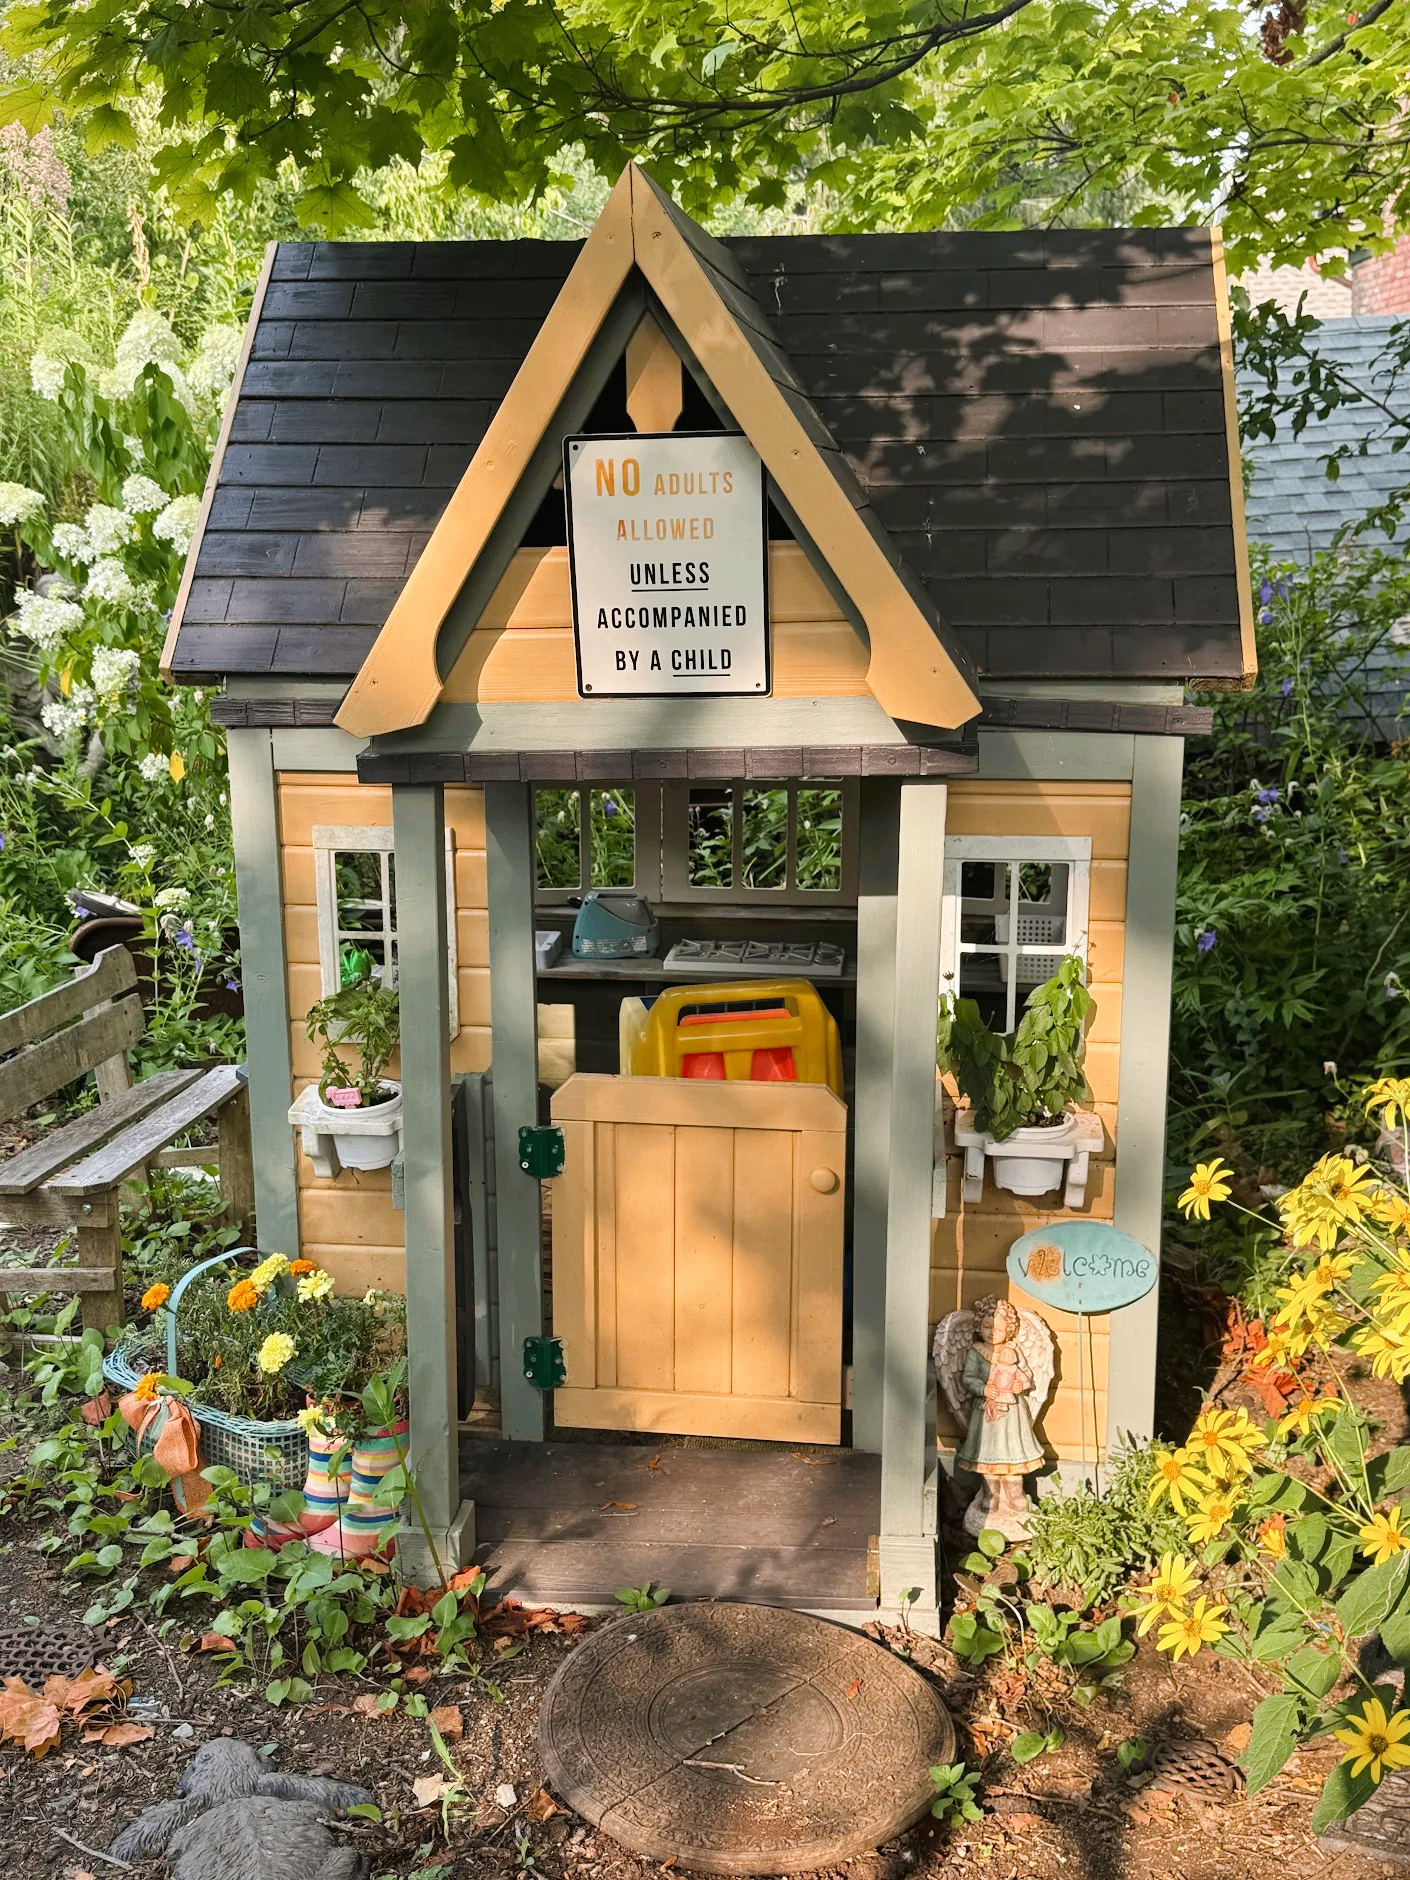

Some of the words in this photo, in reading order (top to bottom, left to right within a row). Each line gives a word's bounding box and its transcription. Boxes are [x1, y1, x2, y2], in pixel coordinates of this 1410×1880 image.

[596, 458, 640, 496] NO
[654, 472, 733, 495] ADULTS
[616, 518, 714, 541] ALLOWED
[630, 562, 710, 585] UNLESS
[597, 605, 746, 628] ACCOMPANIED
[615, 650, 640, 671] BY
[650, 650, 662, 671] A
[671, 649, 732, 671] CHILD
